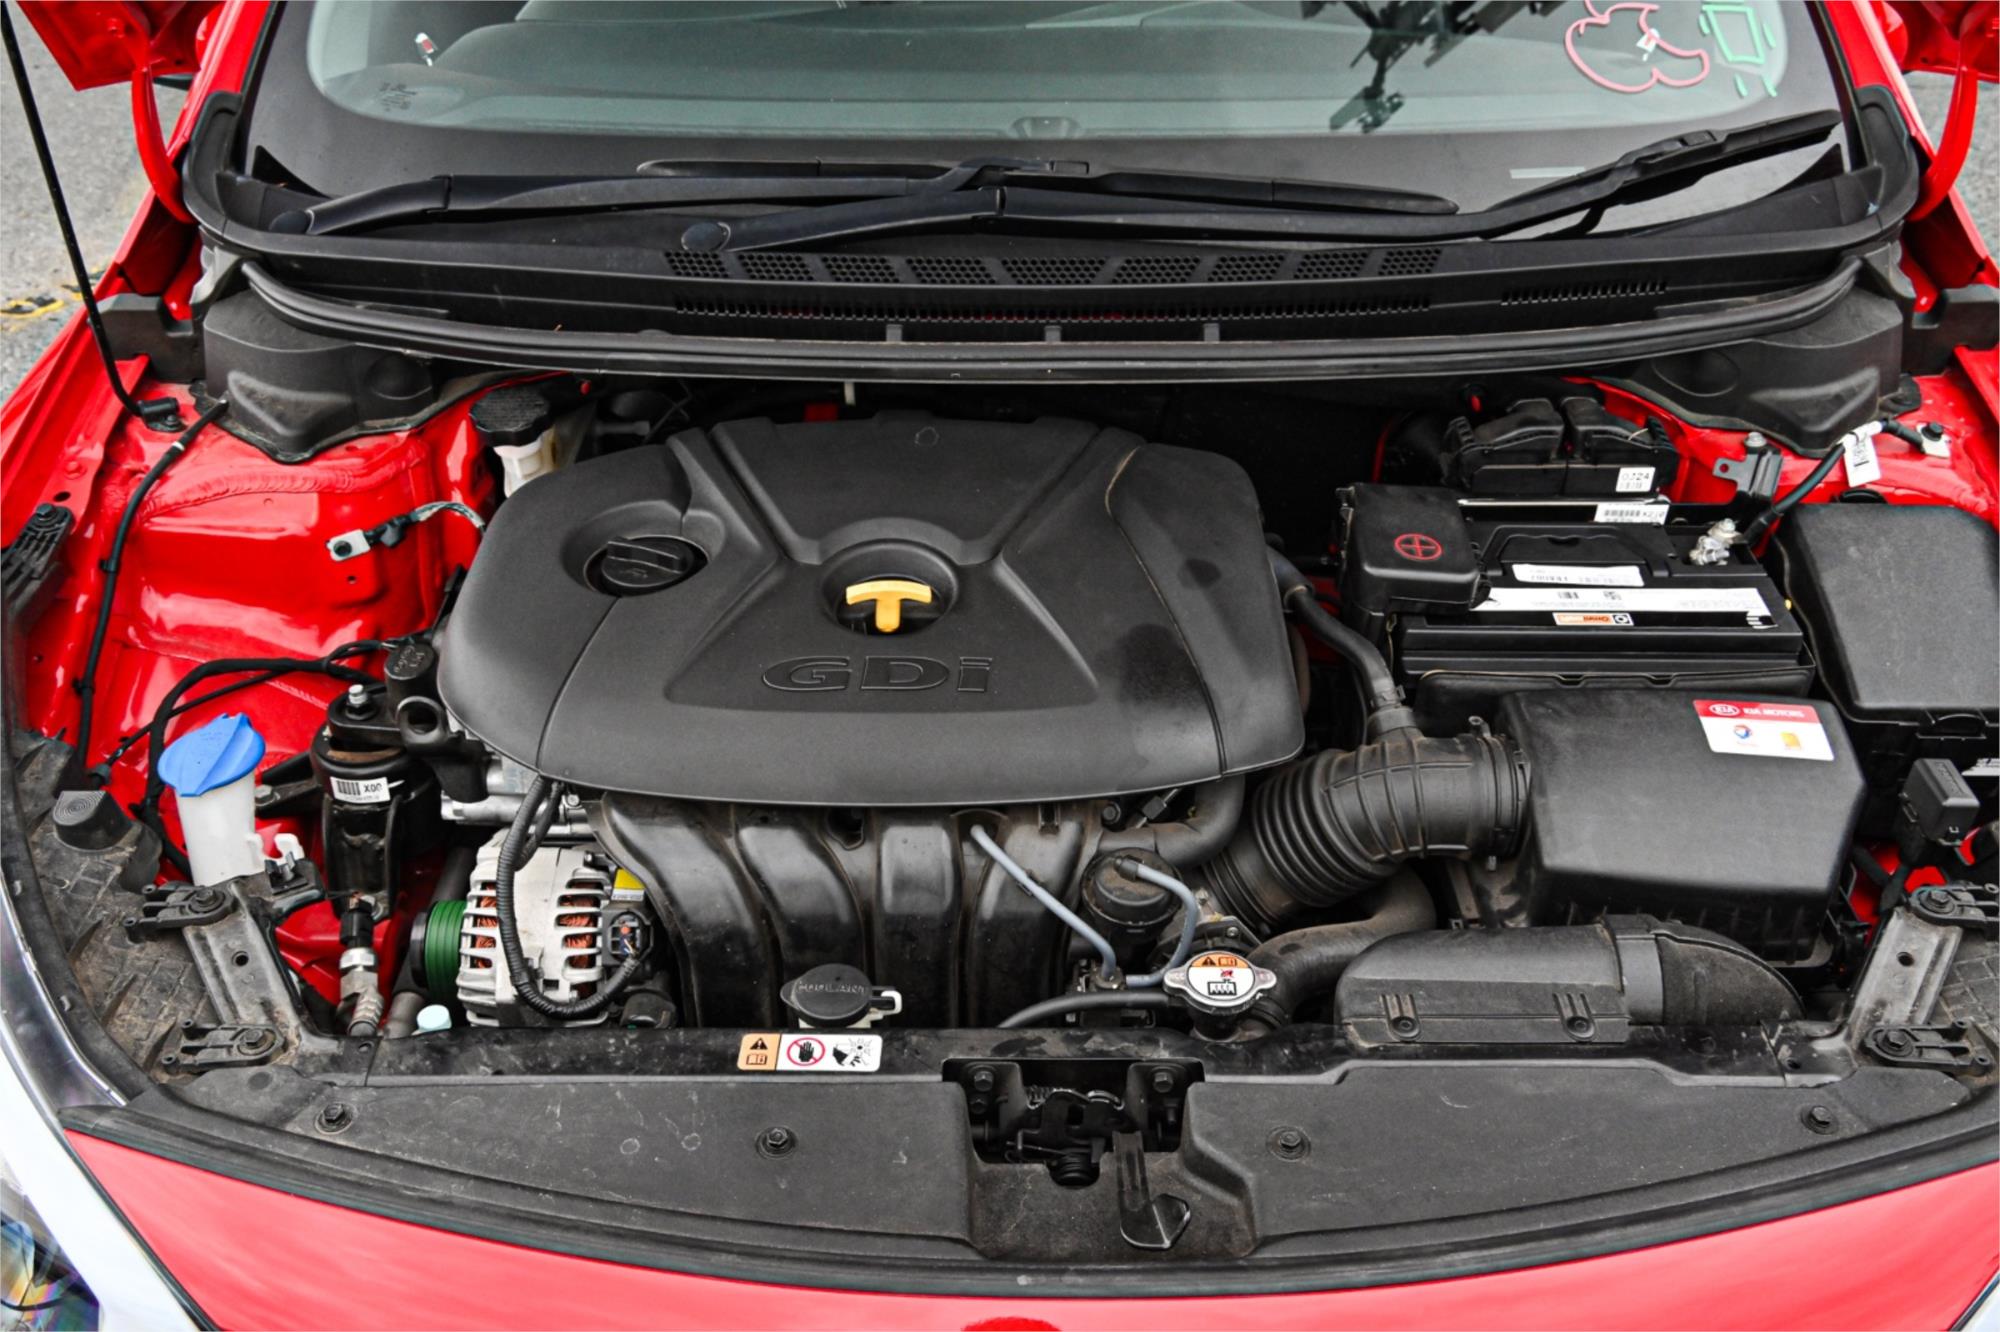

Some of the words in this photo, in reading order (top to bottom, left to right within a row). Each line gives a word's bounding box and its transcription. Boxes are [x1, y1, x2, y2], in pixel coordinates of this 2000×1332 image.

[763, 656, 993, 692] GDi
[1743, 707, 1761, 716] KIA
[1762, 709, 1805, 719] MOTORS
